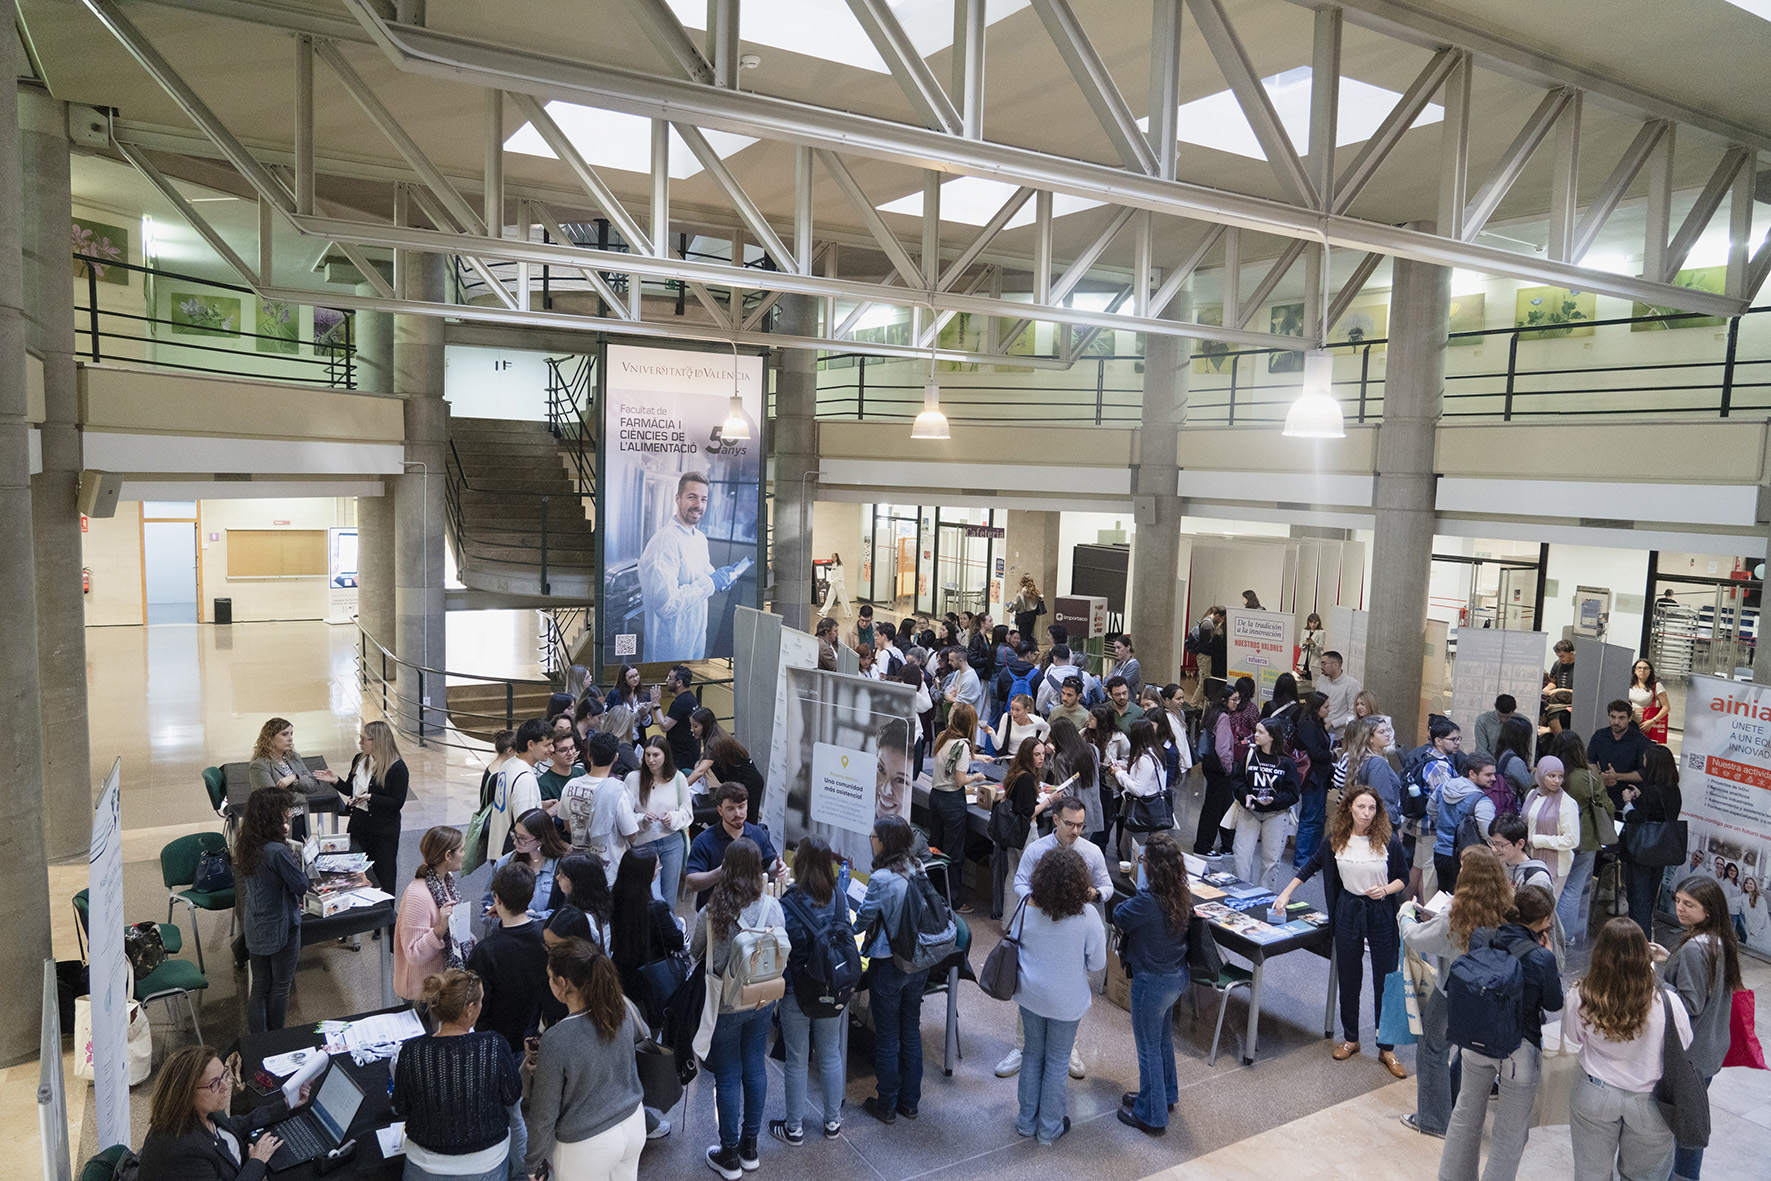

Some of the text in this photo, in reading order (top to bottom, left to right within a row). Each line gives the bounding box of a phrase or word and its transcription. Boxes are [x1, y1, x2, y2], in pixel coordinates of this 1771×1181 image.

[620, 404, 667, 415] Facultat de
[620, 417, 681, 429] FARMÀCIA I
[620, 428, 685, 442] CIÈNCIES DE
[620, 441, 697, 454] L'ALIMENTACIÓ
[721, 446, 746, 457] anys
[966, 528, 1003, 538] Cafeteria
[1255, 622, 1282, 630] tradición
[1249, 628, 1281, 638] innovación
[1234, 640, 1283, 652] NUESTROS VALORES
[1710, 695, 1771, 722] ainia
[1731, 720, 1764, 735] ÚNETE
[1730, 732, 1736, 740] A
[1712, 758, 1741, 772] Nuestra
[1254, 772, 1278, 787] NY
[836, 781, 863, 792] comunidad
[836, 789, 862, 800] asistencial
[1704, 817, 1723, 826] contigo
[1742, 828, 1758, 837] futuro
